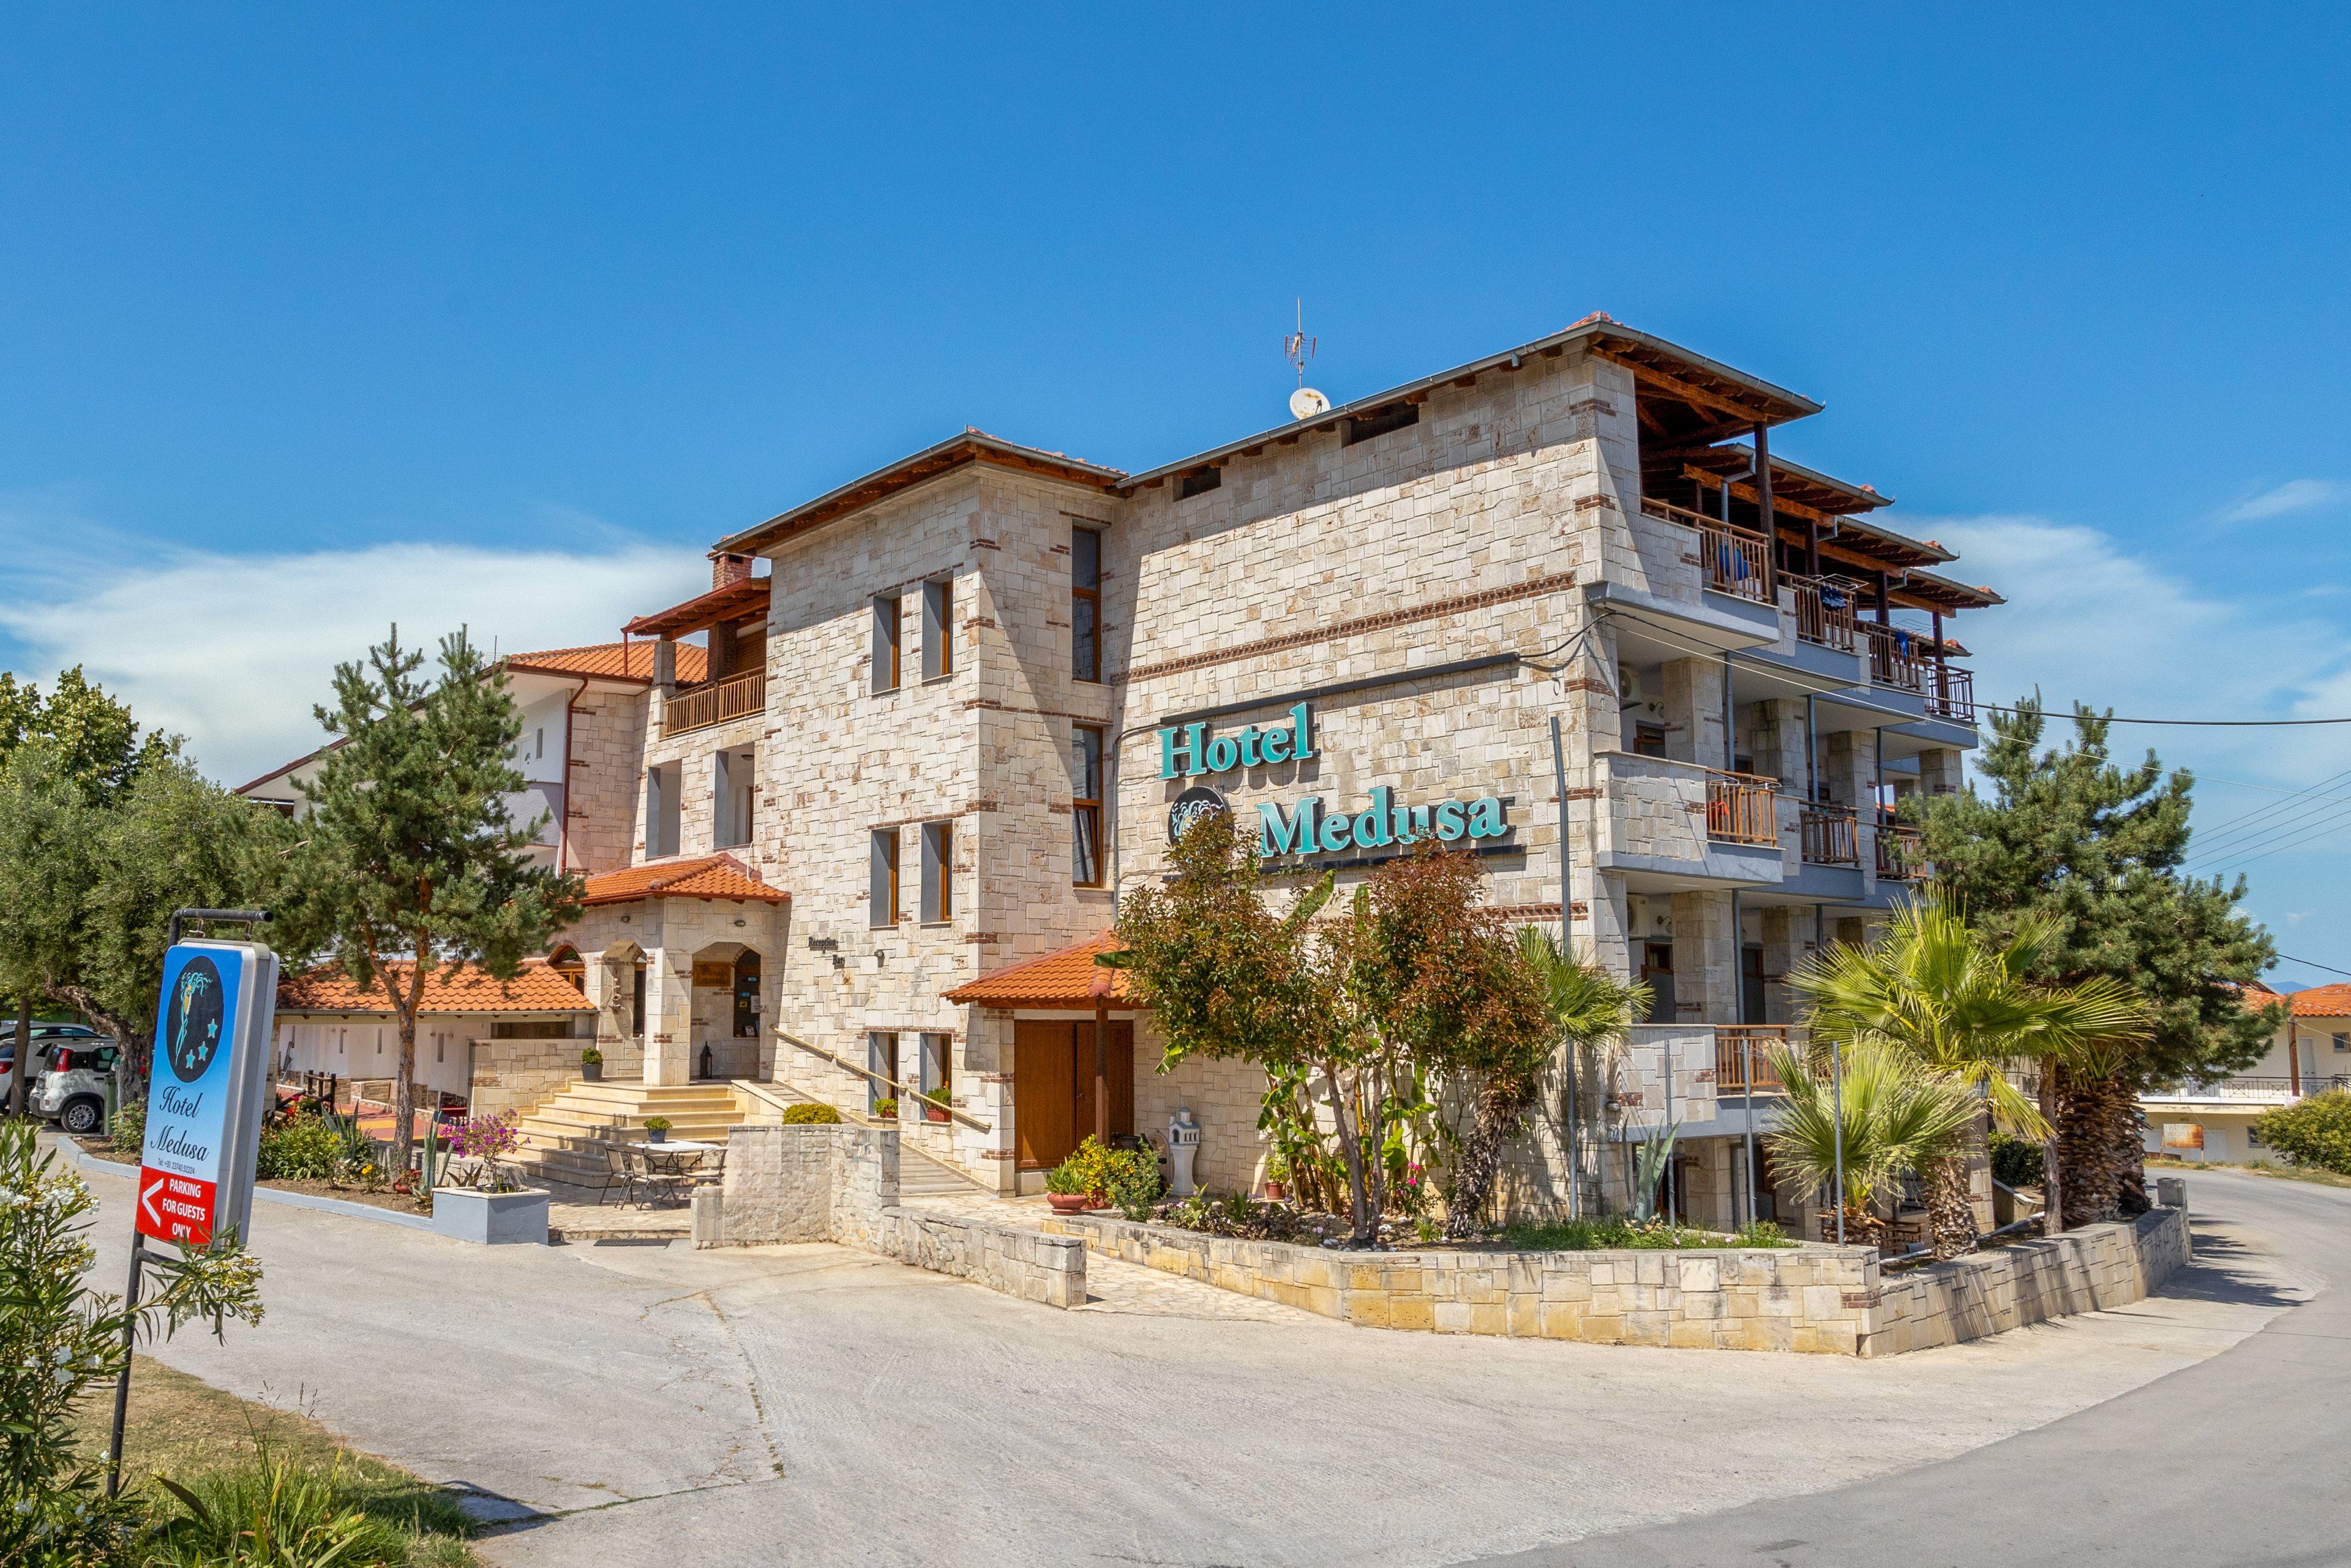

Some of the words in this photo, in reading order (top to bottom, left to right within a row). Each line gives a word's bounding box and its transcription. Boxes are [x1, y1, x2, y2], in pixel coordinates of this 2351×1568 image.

[1158, 702, 1314, 780] Hotel
[1255, 786, 1508, 858] Medusa
[809, 937, 836, 949] Reception
[833, 955, 843, 965] Bar
[159, 1086, 203, 1118] Hotel
[150, 1125, 209, 1161] Medusa
[169, 1178, 201, 1198] PARKING
[162, 1198, 176, 1214] FOR
[177, 1202, 206, 1221] GUESTS
